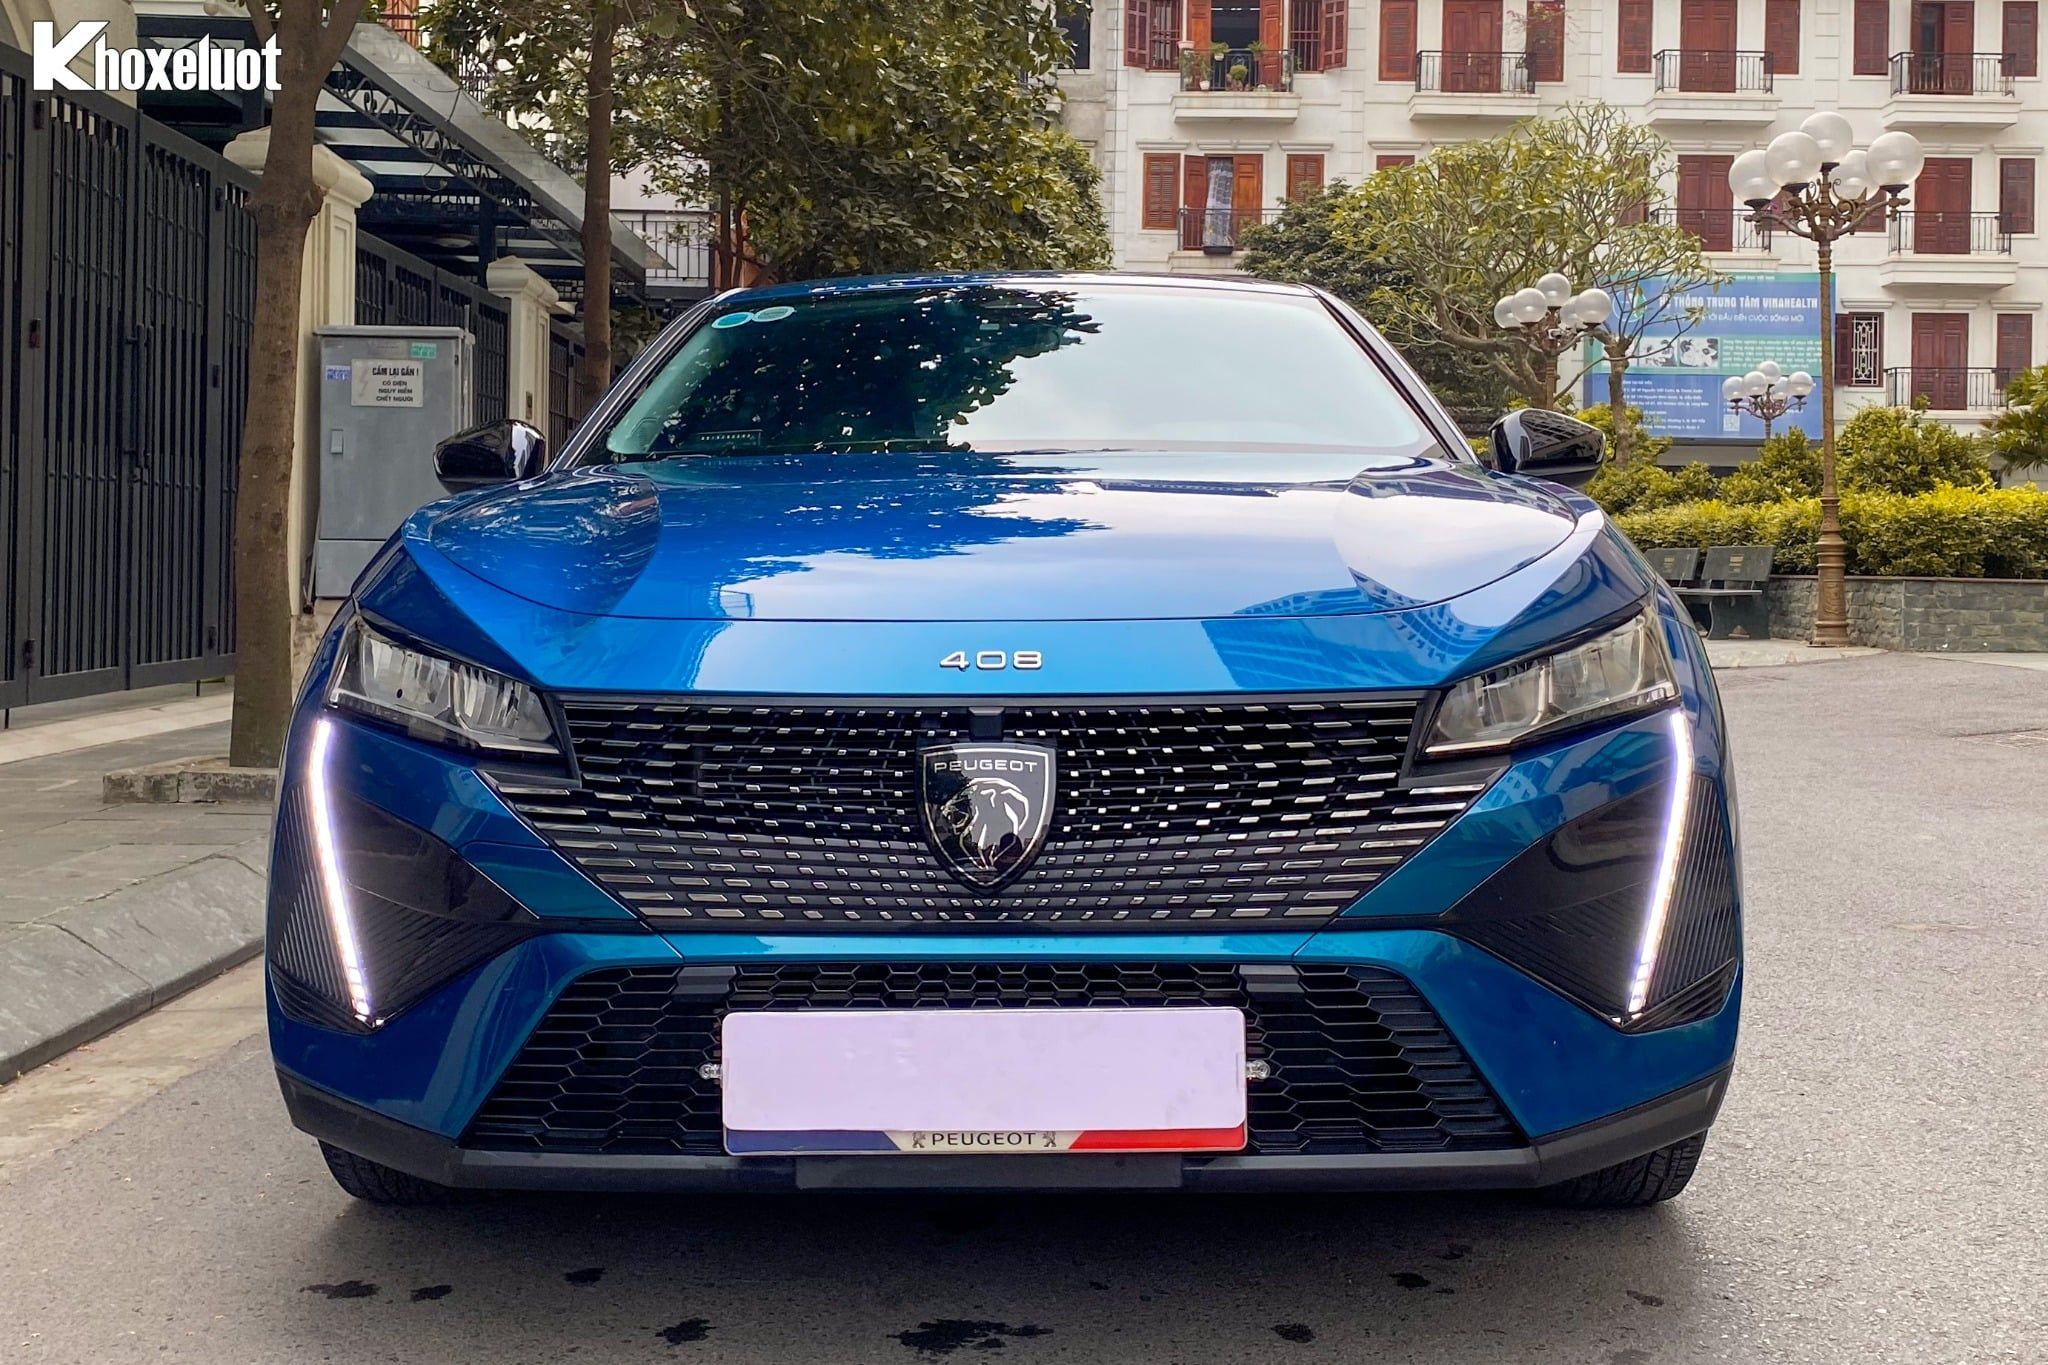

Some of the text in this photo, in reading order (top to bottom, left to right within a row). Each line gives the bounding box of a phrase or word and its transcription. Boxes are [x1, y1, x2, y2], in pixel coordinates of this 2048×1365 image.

[1706, 296, 1737, 308] TRUNG
[1762, 297, 1818, 309] VINAHEALTH
[940, 650, 1042, 671] 408
[934, 759, 1038, 773] PEUGEOT
[932, 1132, 1036, 1146] PEUGEOT
